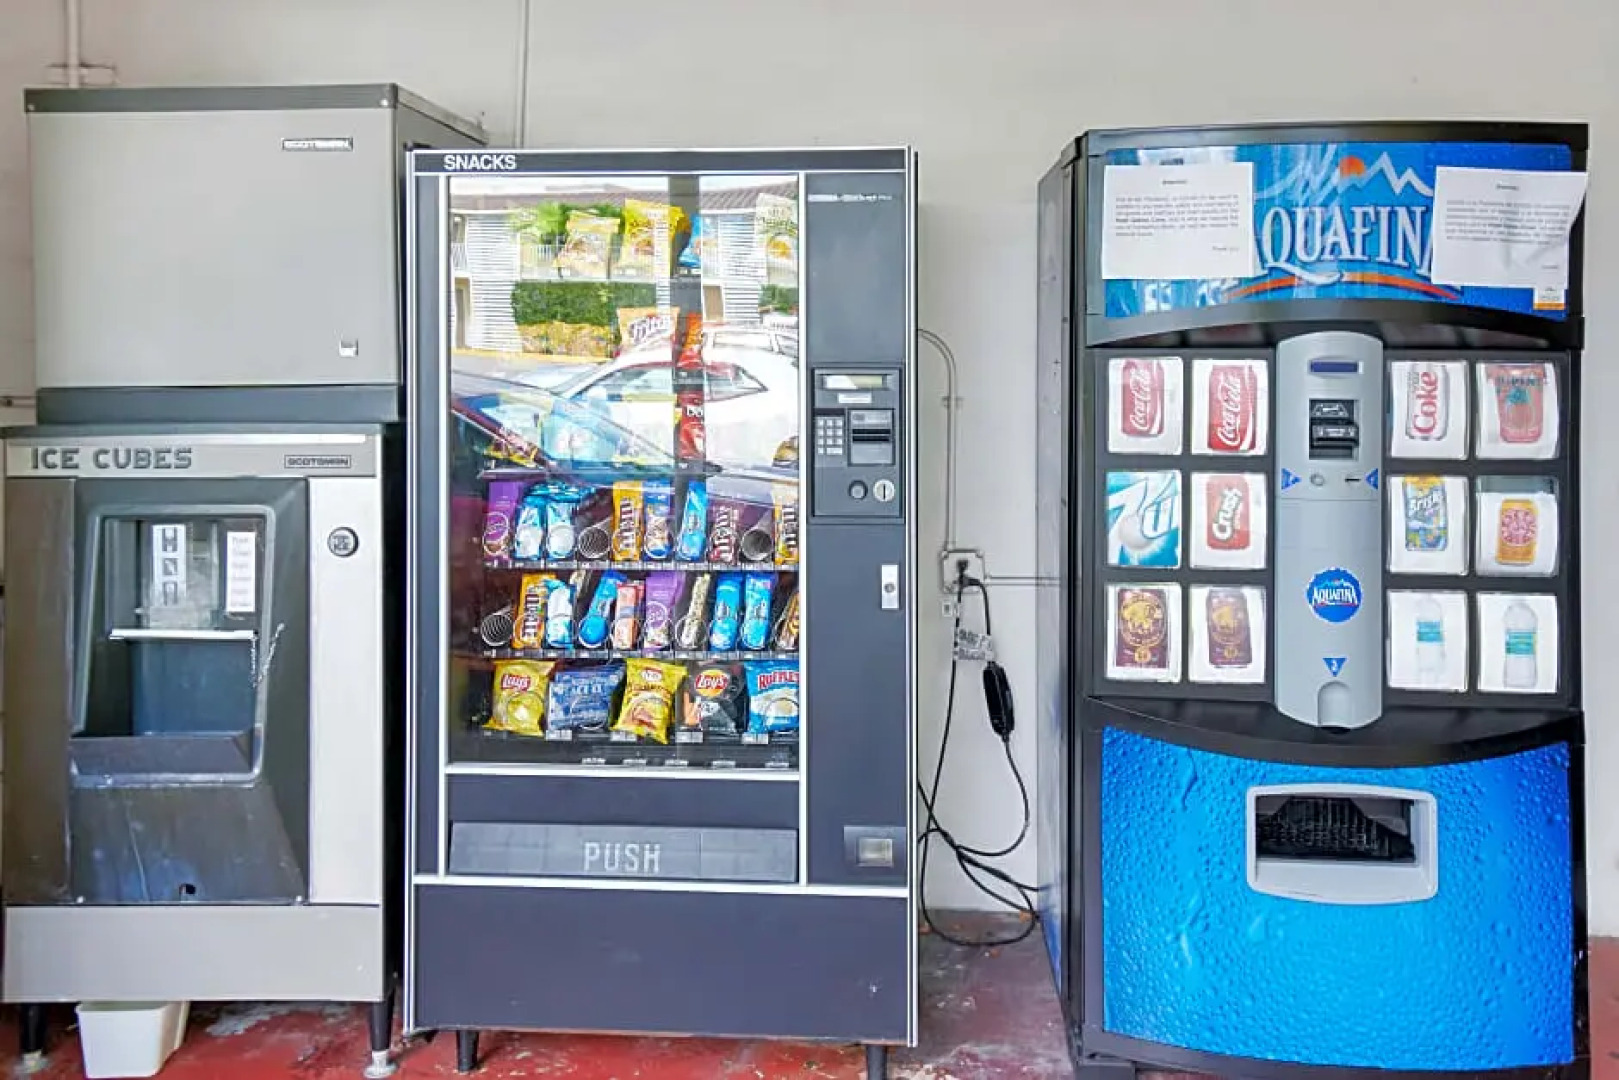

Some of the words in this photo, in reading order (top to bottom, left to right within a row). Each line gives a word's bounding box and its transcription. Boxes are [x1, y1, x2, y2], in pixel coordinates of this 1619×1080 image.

[443, 154, 517, 170] SNACKS
[1253, 205, 1430, 285] QUAFIN
[1412, 371, 1439, 434] Coke
[31, 447, 80, 469] ICE
[92, 446, 193, 469] CUBES
[696, 673, 727, 688] Lay's
[583, 842, 661, 873] PUSH
